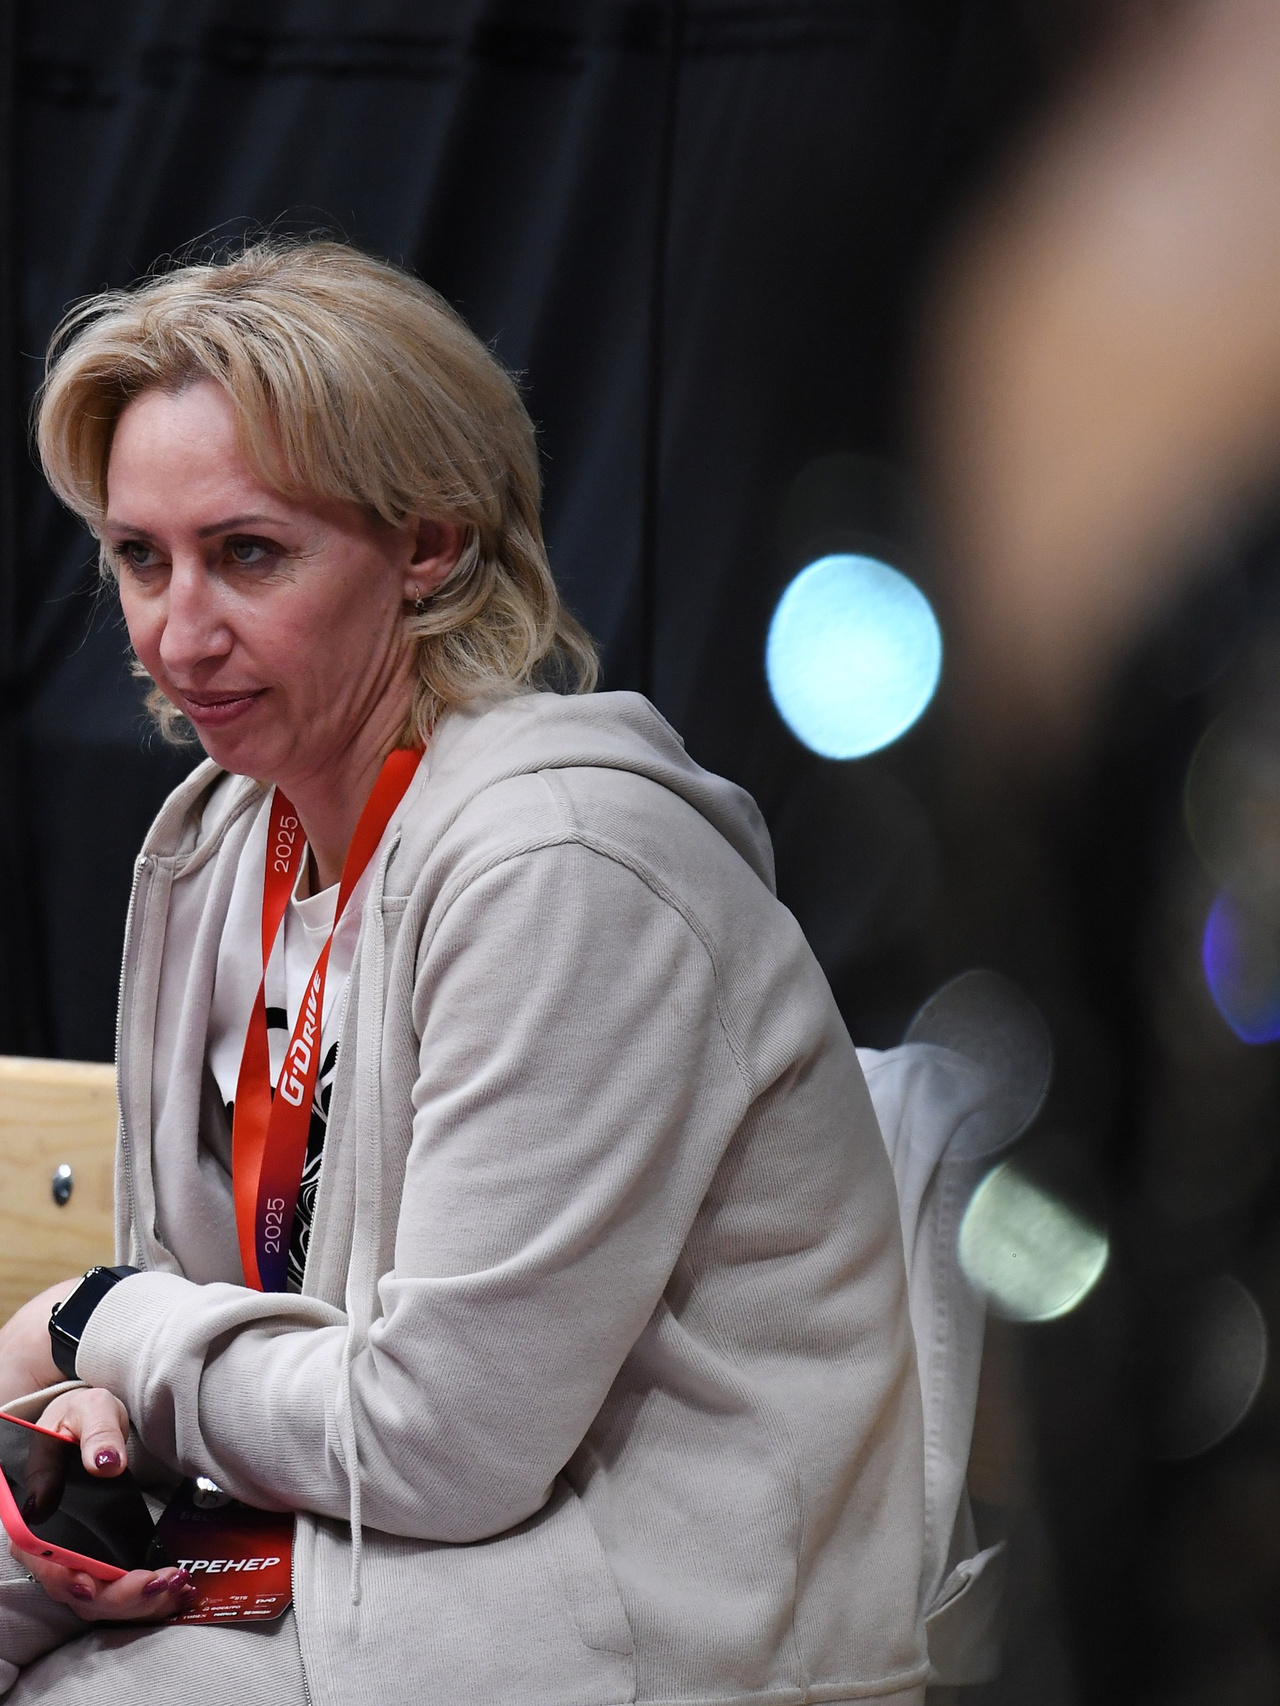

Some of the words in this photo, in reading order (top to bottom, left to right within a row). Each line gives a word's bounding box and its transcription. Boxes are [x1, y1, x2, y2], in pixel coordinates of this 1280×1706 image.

[274, 815, 298, 874] 2025
[264, 1198, 286, 1254] 2025
[177, 1557, 280, 1574] ТРЕНЕР
